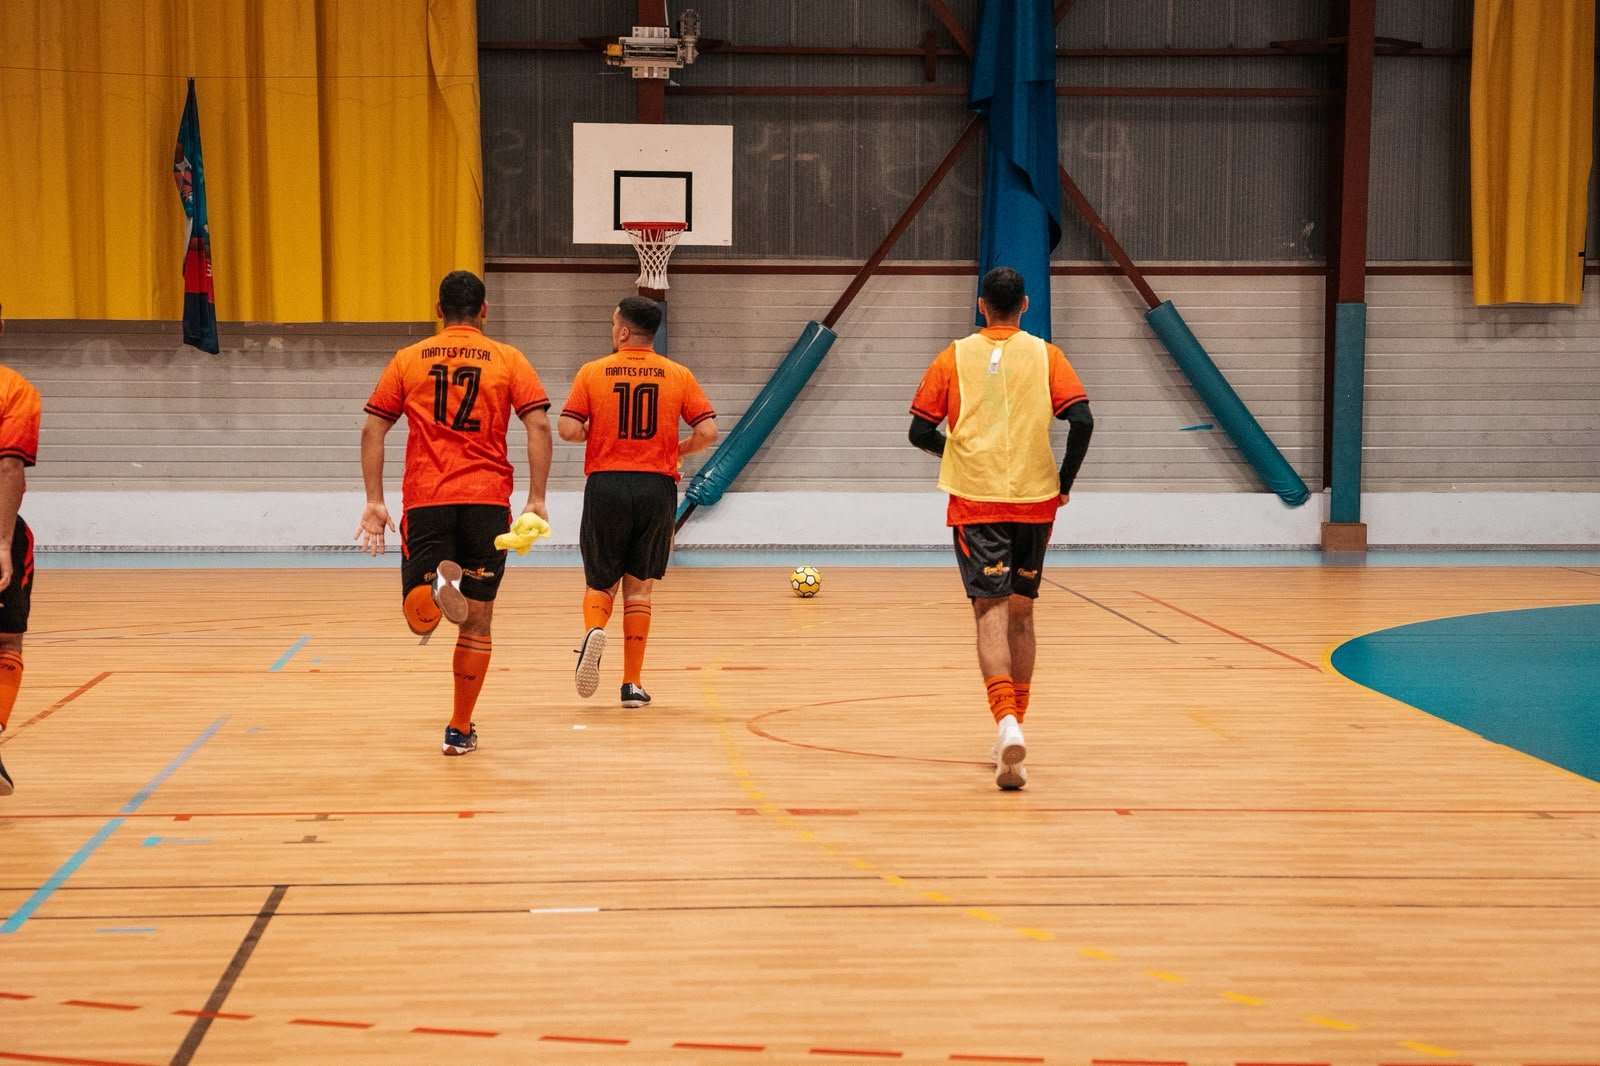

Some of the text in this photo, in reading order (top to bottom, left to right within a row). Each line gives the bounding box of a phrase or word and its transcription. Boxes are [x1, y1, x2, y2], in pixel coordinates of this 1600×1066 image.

[421, 346, 492, 361] MANTES FUTSAL
[605, 366, 666, 378] MANTES FUTSAL
[428, 364, 482, 432] 12
[613, 382, 659, 440] 10
